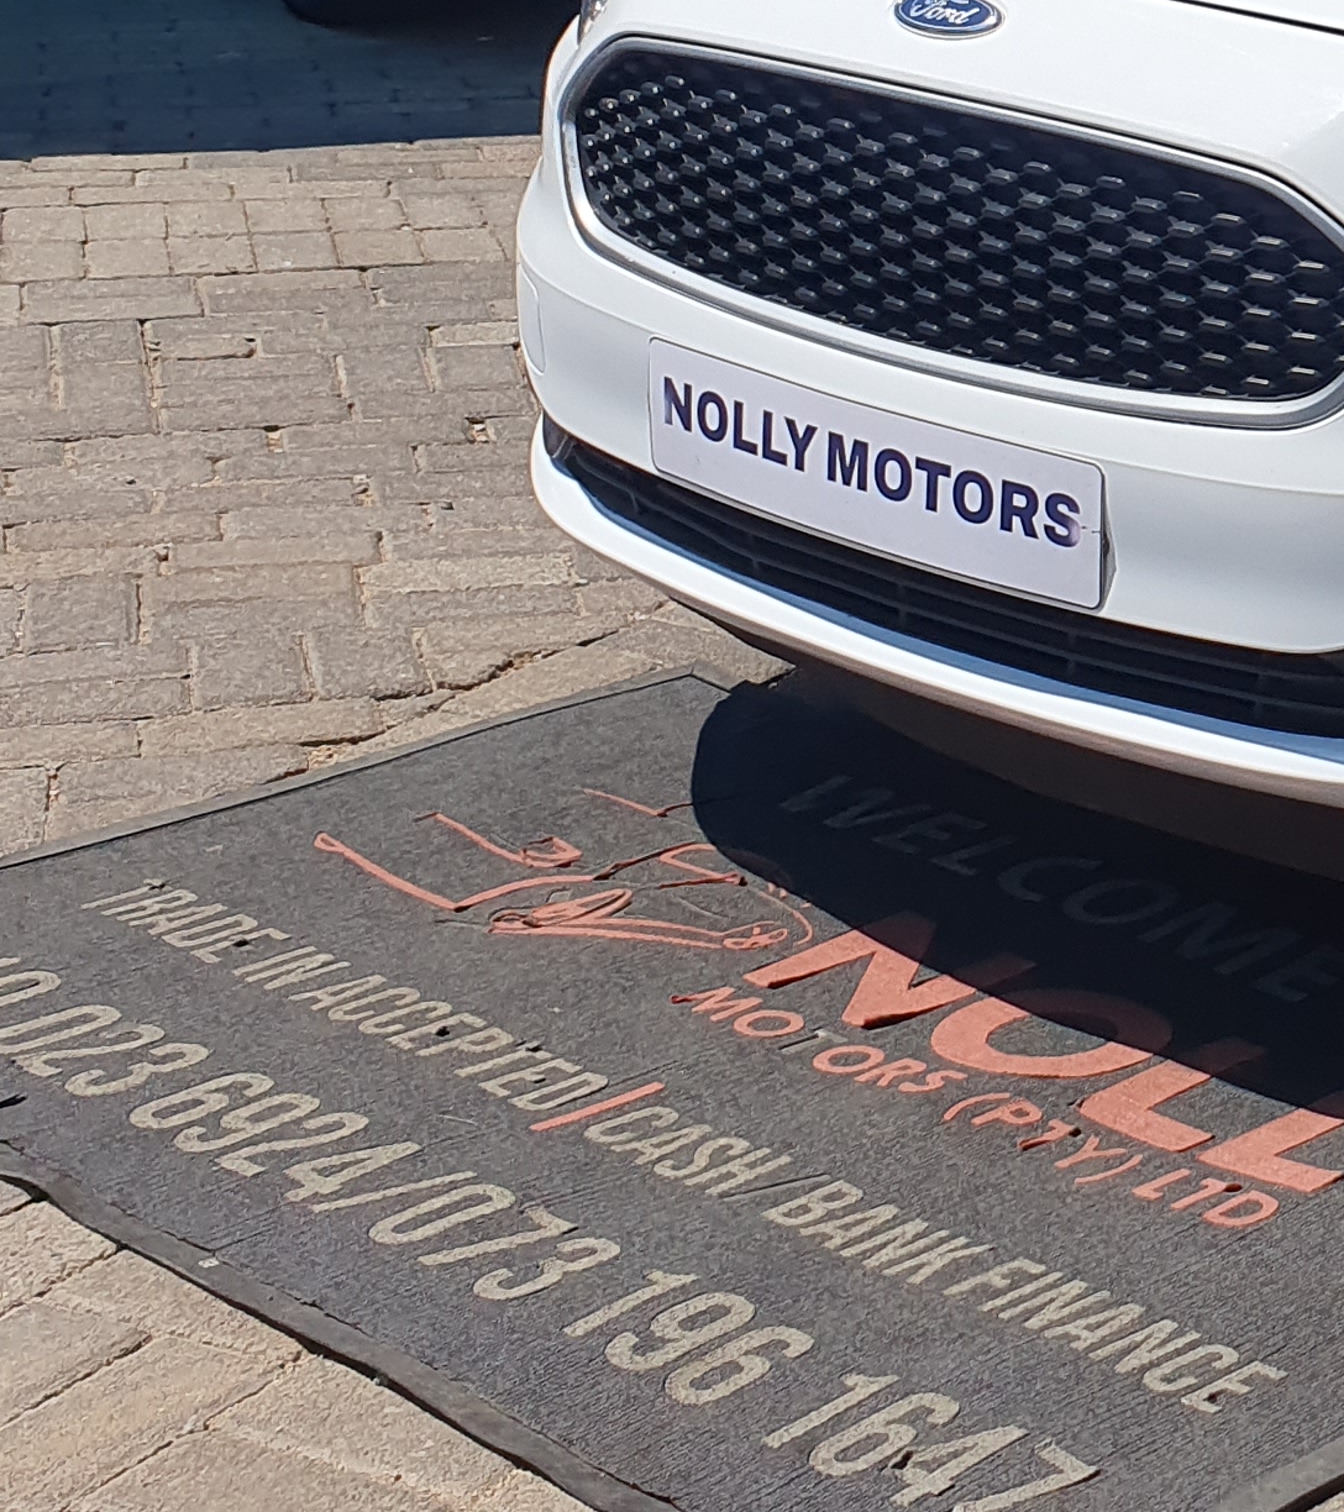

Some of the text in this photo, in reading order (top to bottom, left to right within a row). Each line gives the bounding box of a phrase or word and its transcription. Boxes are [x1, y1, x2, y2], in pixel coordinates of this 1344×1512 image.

[663, 376, 1082, 548] NOLLY MOTORS
[0, 1004, 211, 1098] 023
[562, 1269, 816, 1406] 196
[760, 1372, 1099, 1512] 1647
[80, 877, 293, 964] TRADE
[231, 944, 352, 990] IN
[942, 1255, 1288, 1414] FINANCE
[671, 986, 1280, 1229] MOTORS (PTY) LTD
